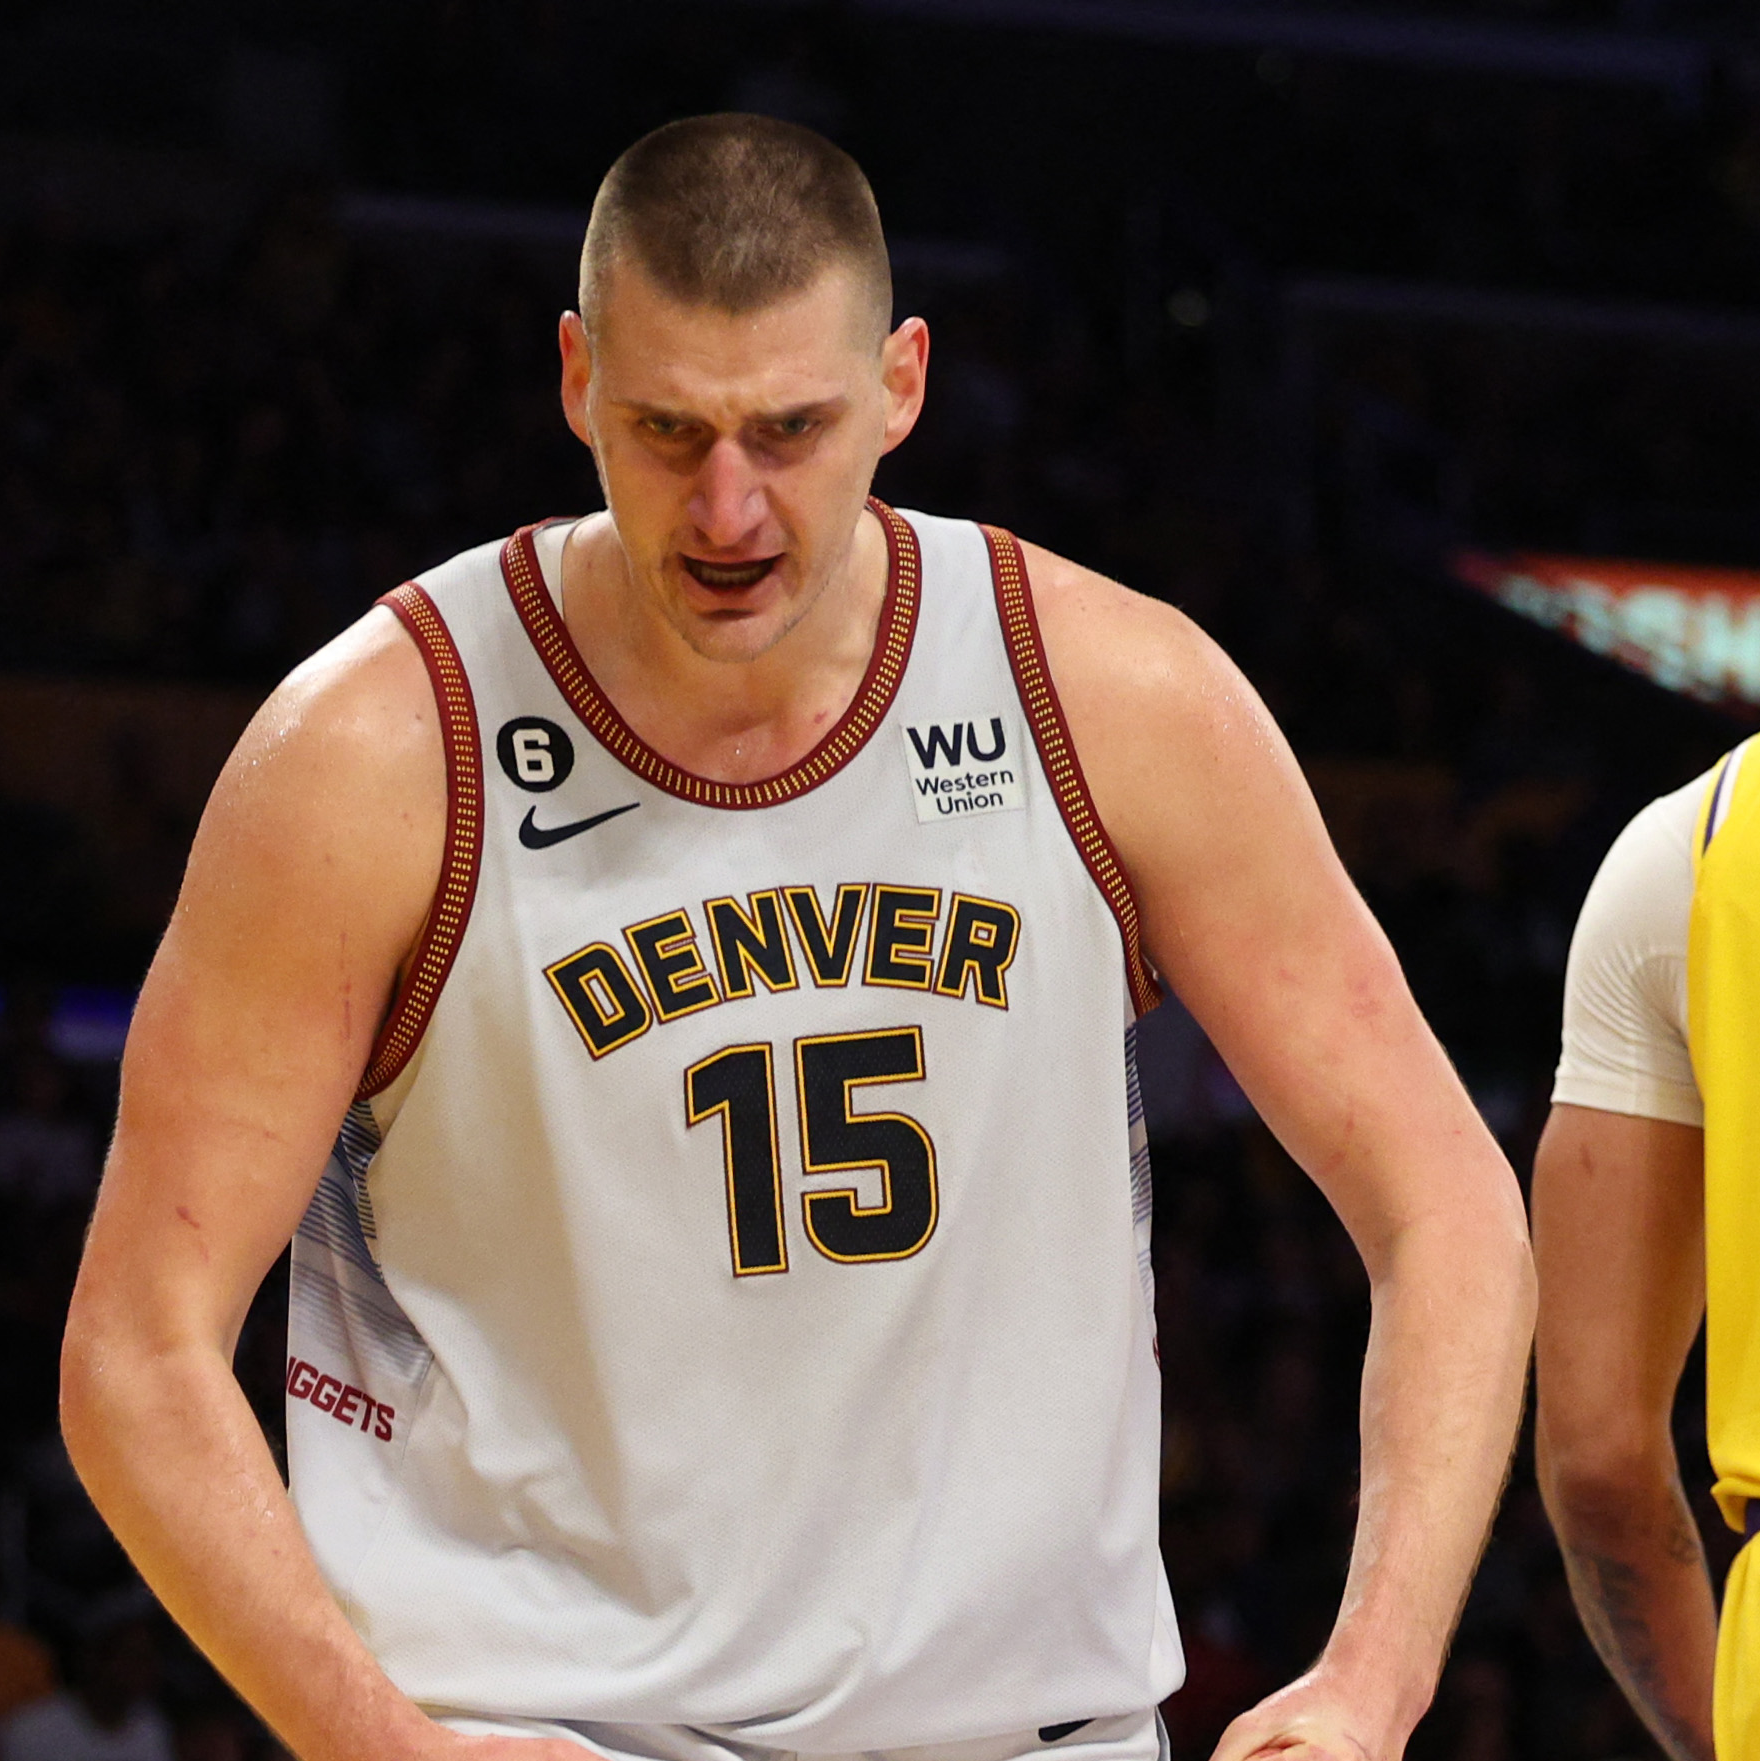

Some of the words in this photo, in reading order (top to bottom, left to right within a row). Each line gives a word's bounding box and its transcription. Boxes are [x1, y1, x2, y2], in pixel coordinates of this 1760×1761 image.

[511, 727, 555, 783] 6
[906, 716, 1006, 770] WU
[915, 769, 1014, 796] Western
[935, 791, 1004, 815] Union
[542, 882, 1021, 1061] DENVER
[684, 1025, 939, 1277] 15
